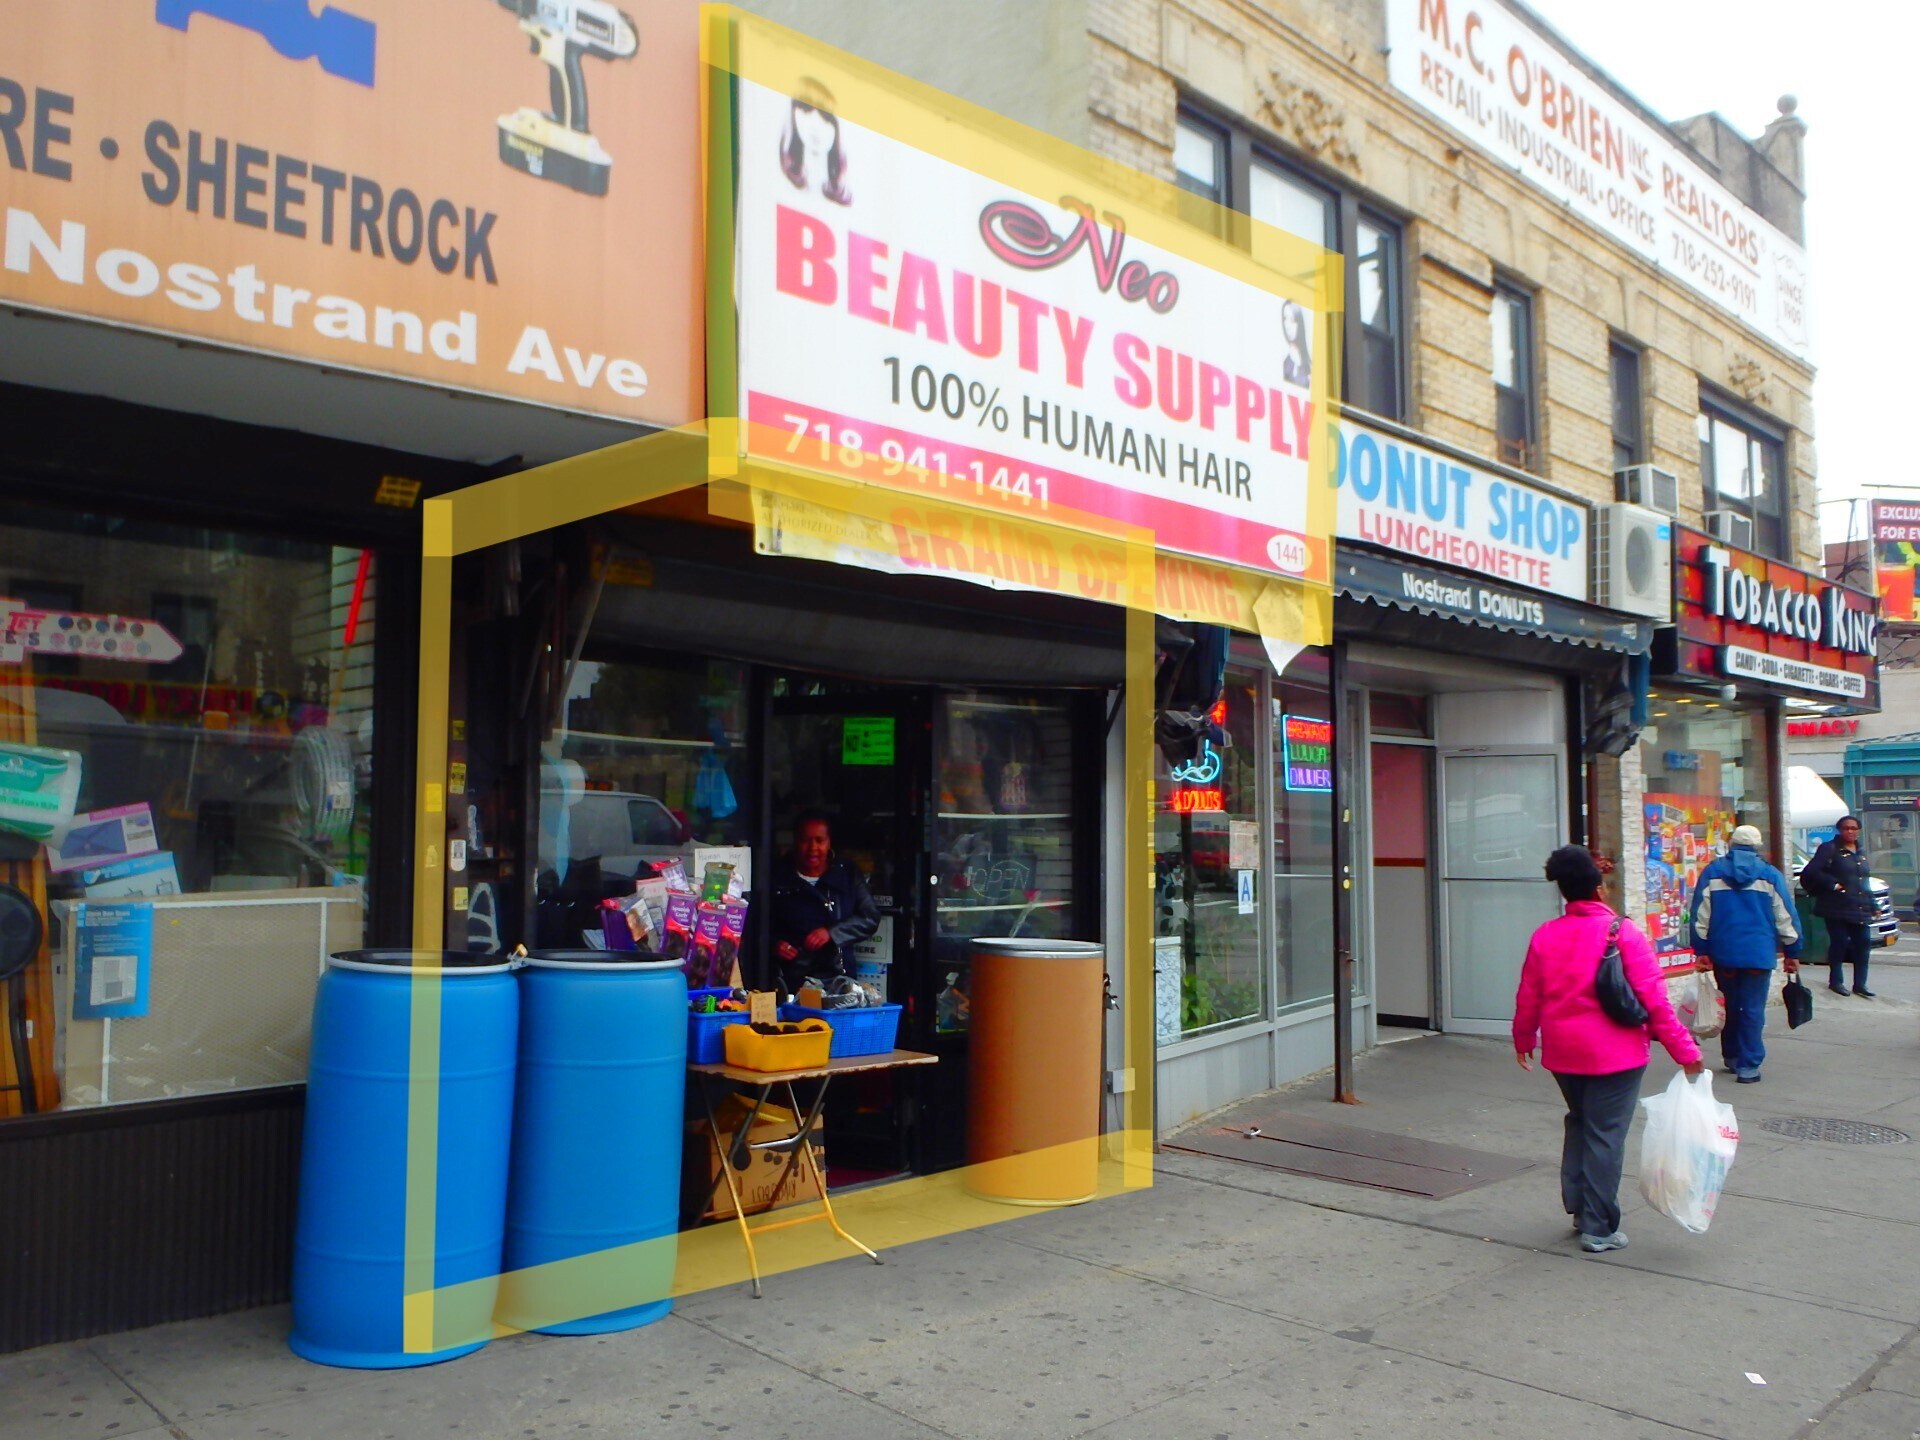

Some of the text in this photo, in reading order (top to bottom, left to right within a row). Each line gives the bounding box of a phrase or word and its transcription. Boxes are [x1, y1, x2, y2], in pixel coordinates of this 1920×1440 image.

[1419, 0, 1495, 83] M.C.
[1507, 44, 1625, 179] O'BRIEN
[1661, 161, 1759, 265] REALTORS
[1420, 51, 1656, 245] RETAIL INDUSTRIAL OFFICE
[142, 119, 499, 286] SHEETROCK
[979, 195, 1180, 314] Neo
[3, 208, 649, 398] Nostrand Ave
[1672, 231, 1757, 315] 718-252-9191
[1777, 273, 1803, 305] SINCE
[776, 203, 1315, 462] BEAUTY SUPPLY
[782, 413, 1050, 510] 718-941-1441
[883, 357, 1253, 502] 100% HUMAN HAIR
[1326, 421, 1581, 561] DONUT SHOP
[1880, 526, 1906, 539] FOR
[890, 505, 1240, 622] GRAND OPENING
[1274, 540, 1306, 565] 1441
[1357, 508, 1552, 589] LUNCHEONETTE
[1401, 572, 1545, 626] Nostrand DONUTS
[1706, 545, 1879, 658] TOBACCO KING
[1735, 651, 1757, 671] CANDY
[1761, 658, 1779, 677] SODA
[1818, 671, 1840, 688] CIGARS
[1843, 676, 1862, 693] COFFEE
[972, 868, 1030, 892] OPEN
[1241, 875, 1251, 902] A
